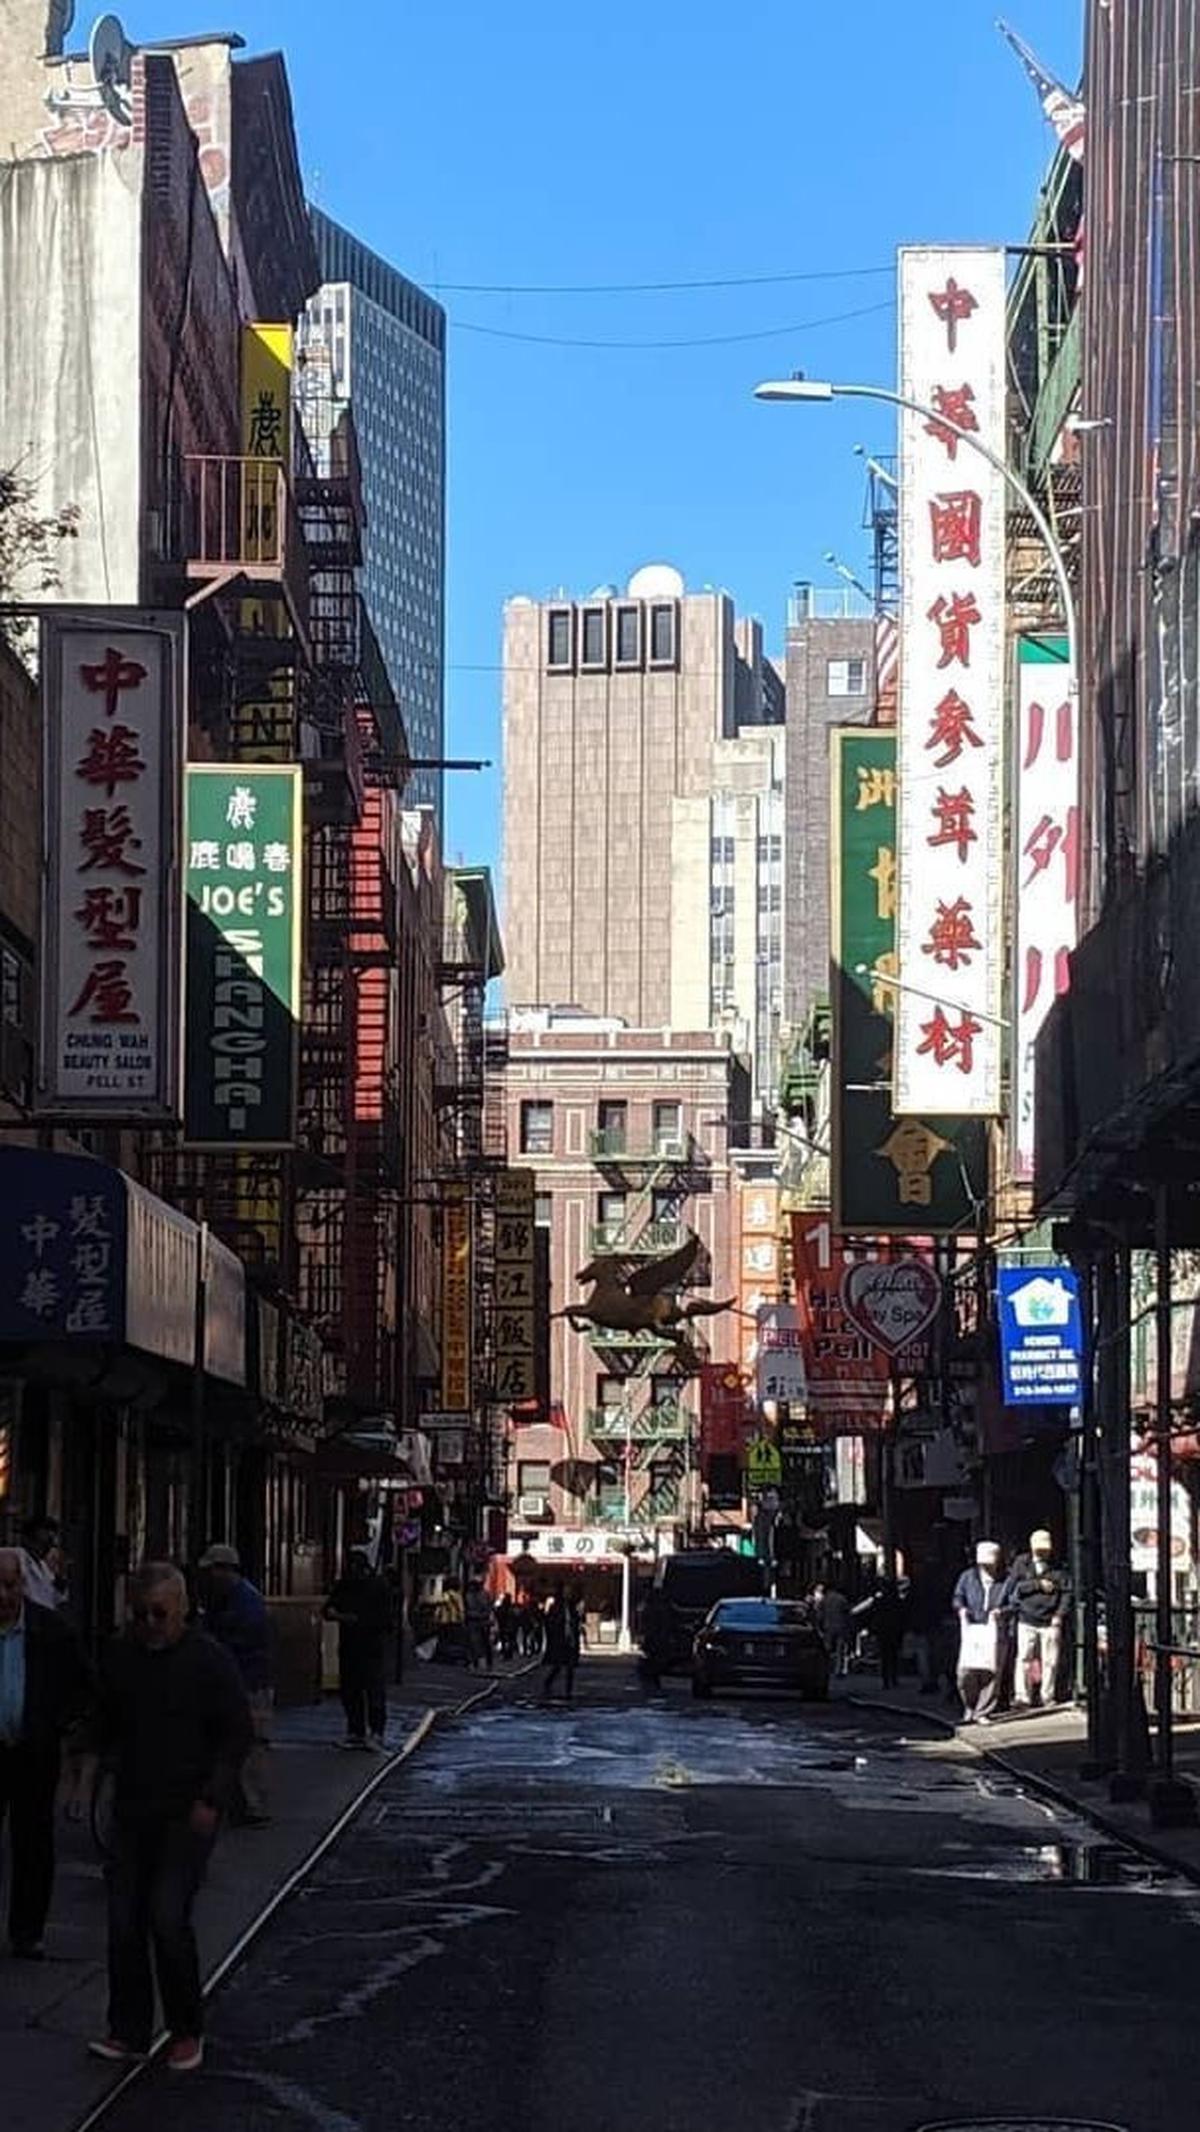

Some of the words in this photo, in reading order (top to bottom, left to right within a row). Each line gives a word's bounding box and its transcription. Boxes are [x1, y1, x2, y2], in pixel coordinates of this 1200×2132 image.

[67, 647, 148, 1025] 中華髮型屋
[200, 882, 285, 917] JOE'S
[67, 1032, 113, 1049] CHUNG
[119, 1033, 150, 1049] WAH
[210, 928, 268, 1131] SHANGHAI
[63, 1053, 109, 1069] BEAUTY
[115, 1053, 151, 1069] SALON
